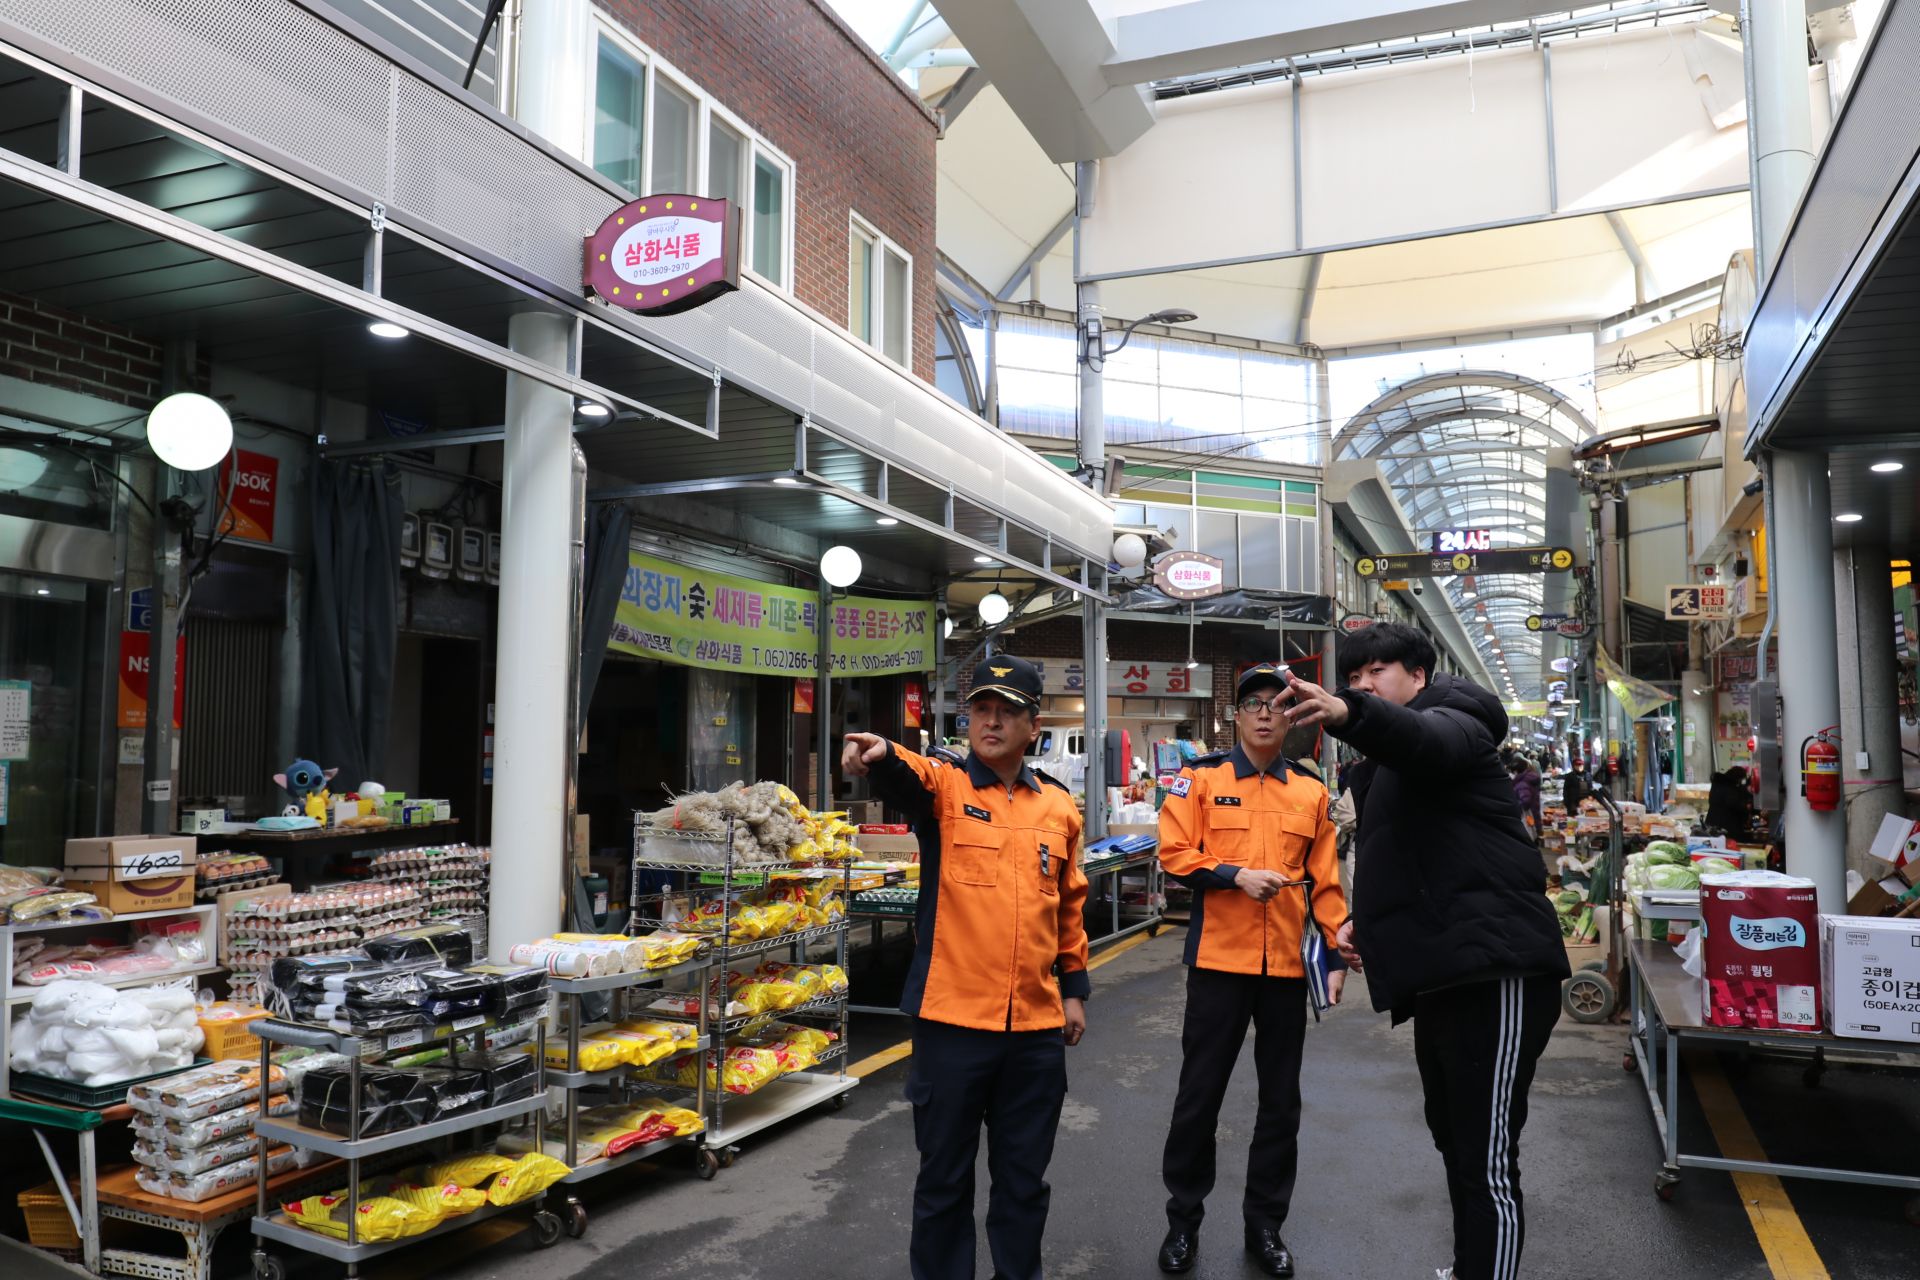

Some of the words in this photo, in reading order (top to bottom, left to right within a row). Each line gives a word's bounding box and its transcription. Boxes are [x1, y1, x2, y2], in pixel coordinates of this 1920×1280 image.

[624, 233, 700, 266] 삼화식품
[633, 262, 690, 278] 010-3609-2970
[1375, 558, 1389, 571] 10
[1470, 554, 1479, 567] 1
[1541, 552, 1552, 565] 4
[1174, 570, 1211, 581] 삼화식품
[712, 586, 763, 629] 세제류
[768, 596, 797, 633] 피존
[803, 602, 818, 636] 락
[835, 606, 860, 639] 퐁퐁
[865, 608, 900, 640] 음료수
[128, 655, 150, 673] NS
[695, 639, 743, 665] 삼화식품
[764, 648, 847, 672] 062)266-07-8
[1123, 664, 1191, 694] 상회
[125, 854, 181, 875] 1600
[1736, 923, 1797, 944] 잘풀리는집
[1862, 966, 1893, 978] 고급형
[1861, 978, 1920, 1000] 종이컵
